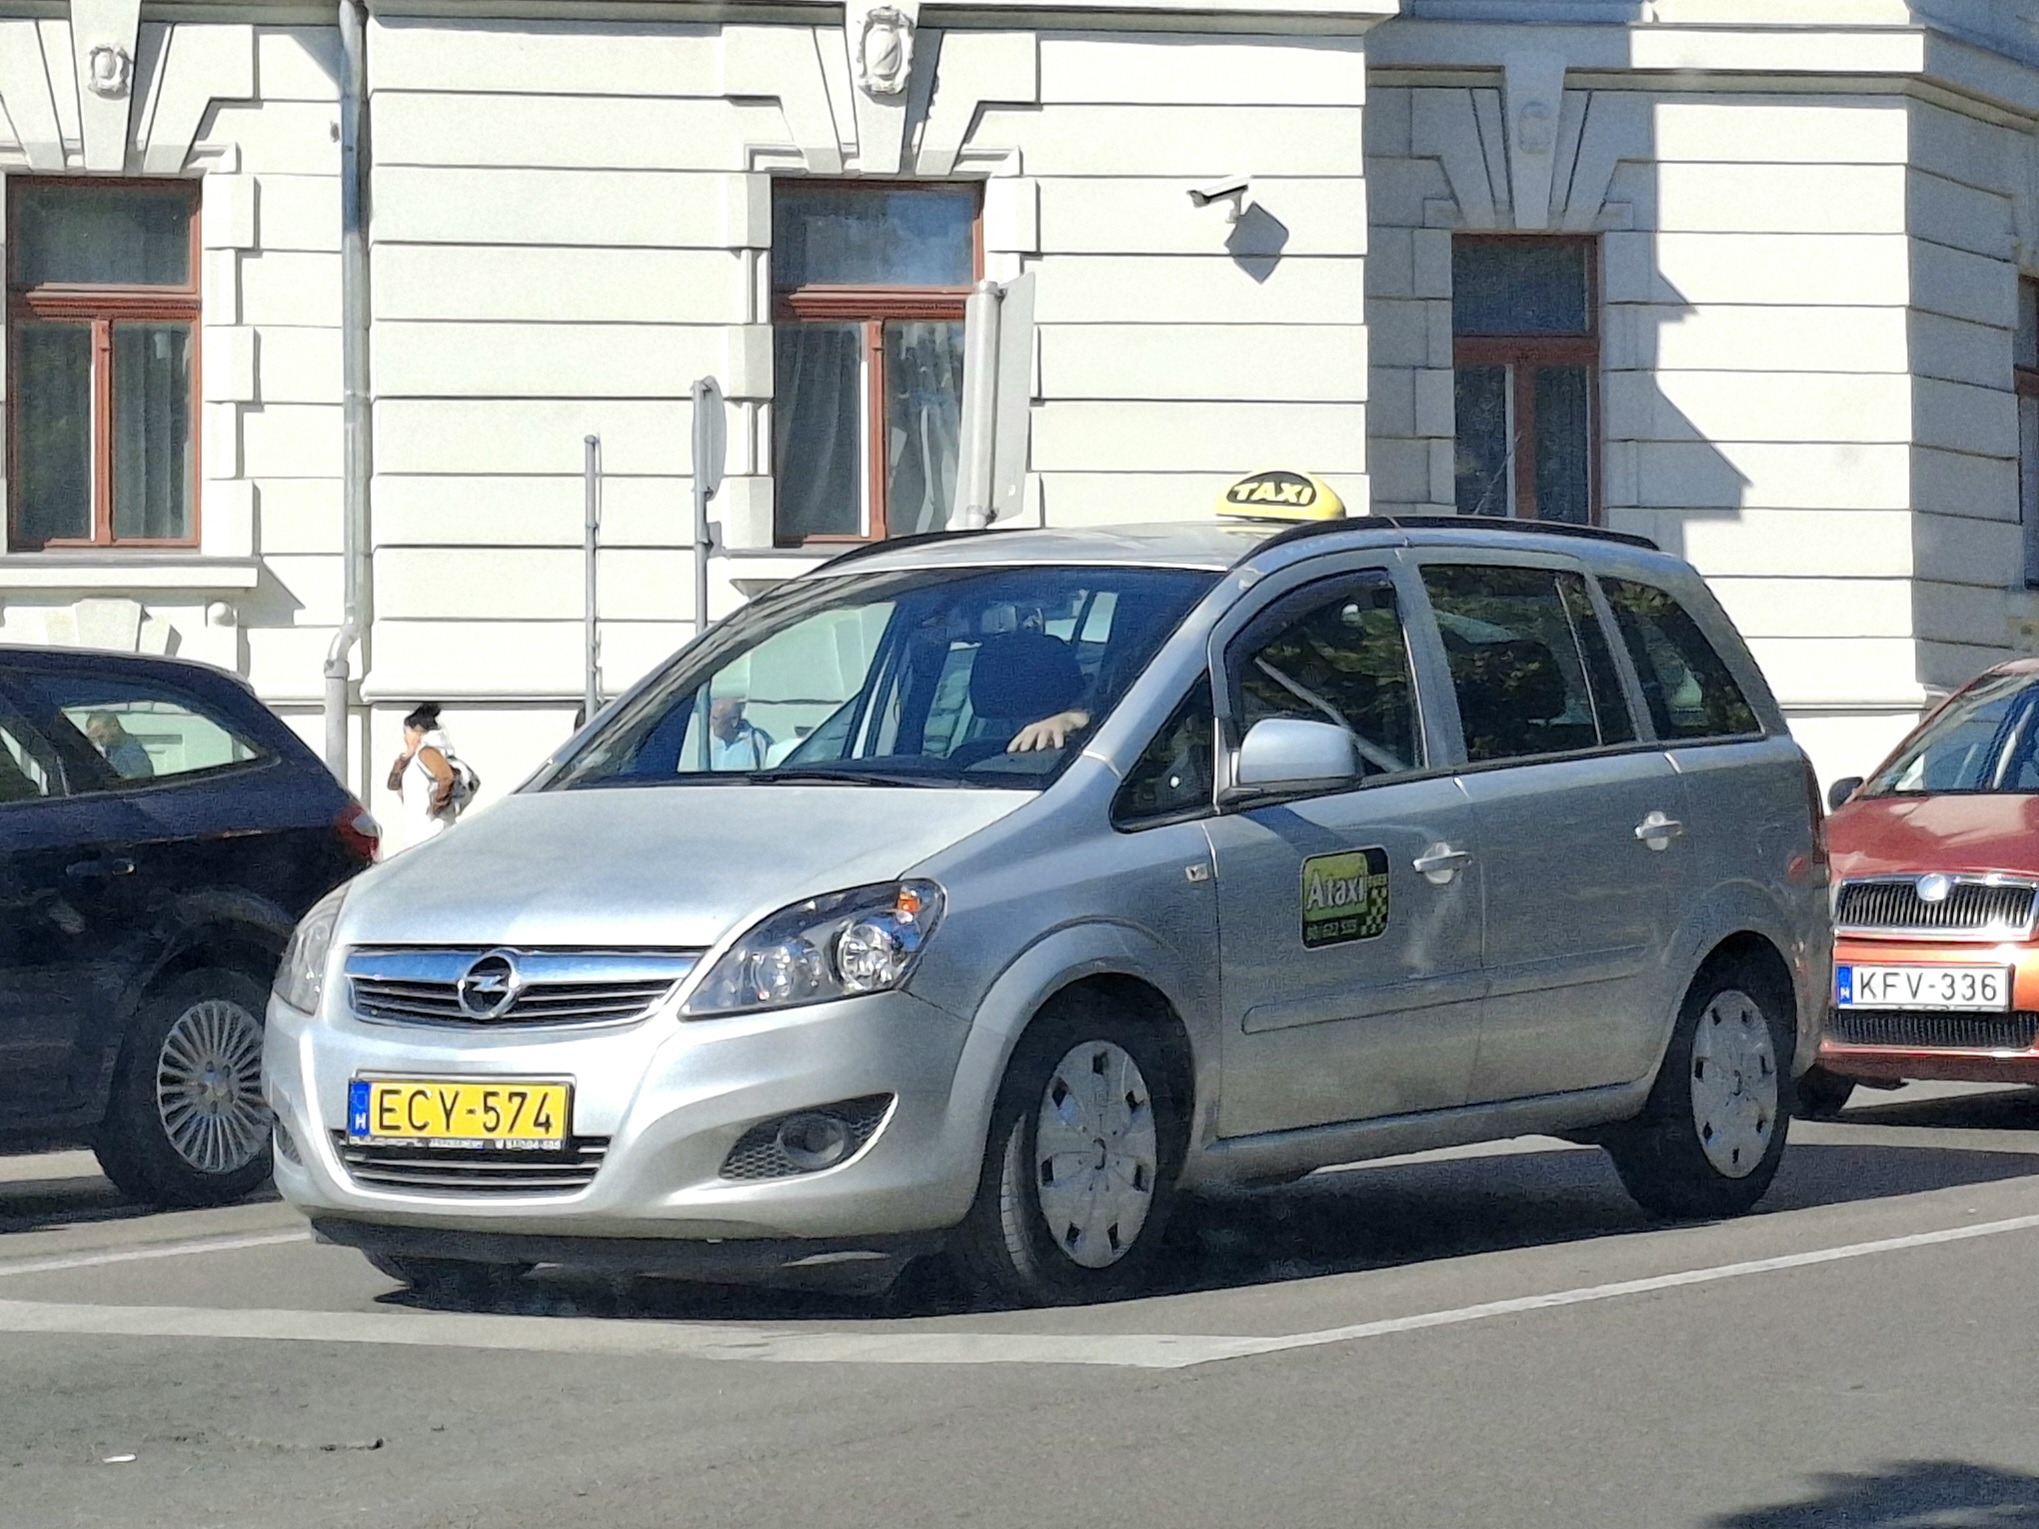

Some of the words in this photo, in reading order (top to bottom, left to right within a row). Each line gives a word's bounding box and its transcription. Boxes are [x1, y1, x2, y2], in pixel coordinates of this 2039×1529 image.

[1233, 481, 1313, 504] TAXI
[1860, 972, 1997, 1001] KFV-336
[355, 1112, 366, 1130] H
[379, 1089, 552, 1134] ECY-574
